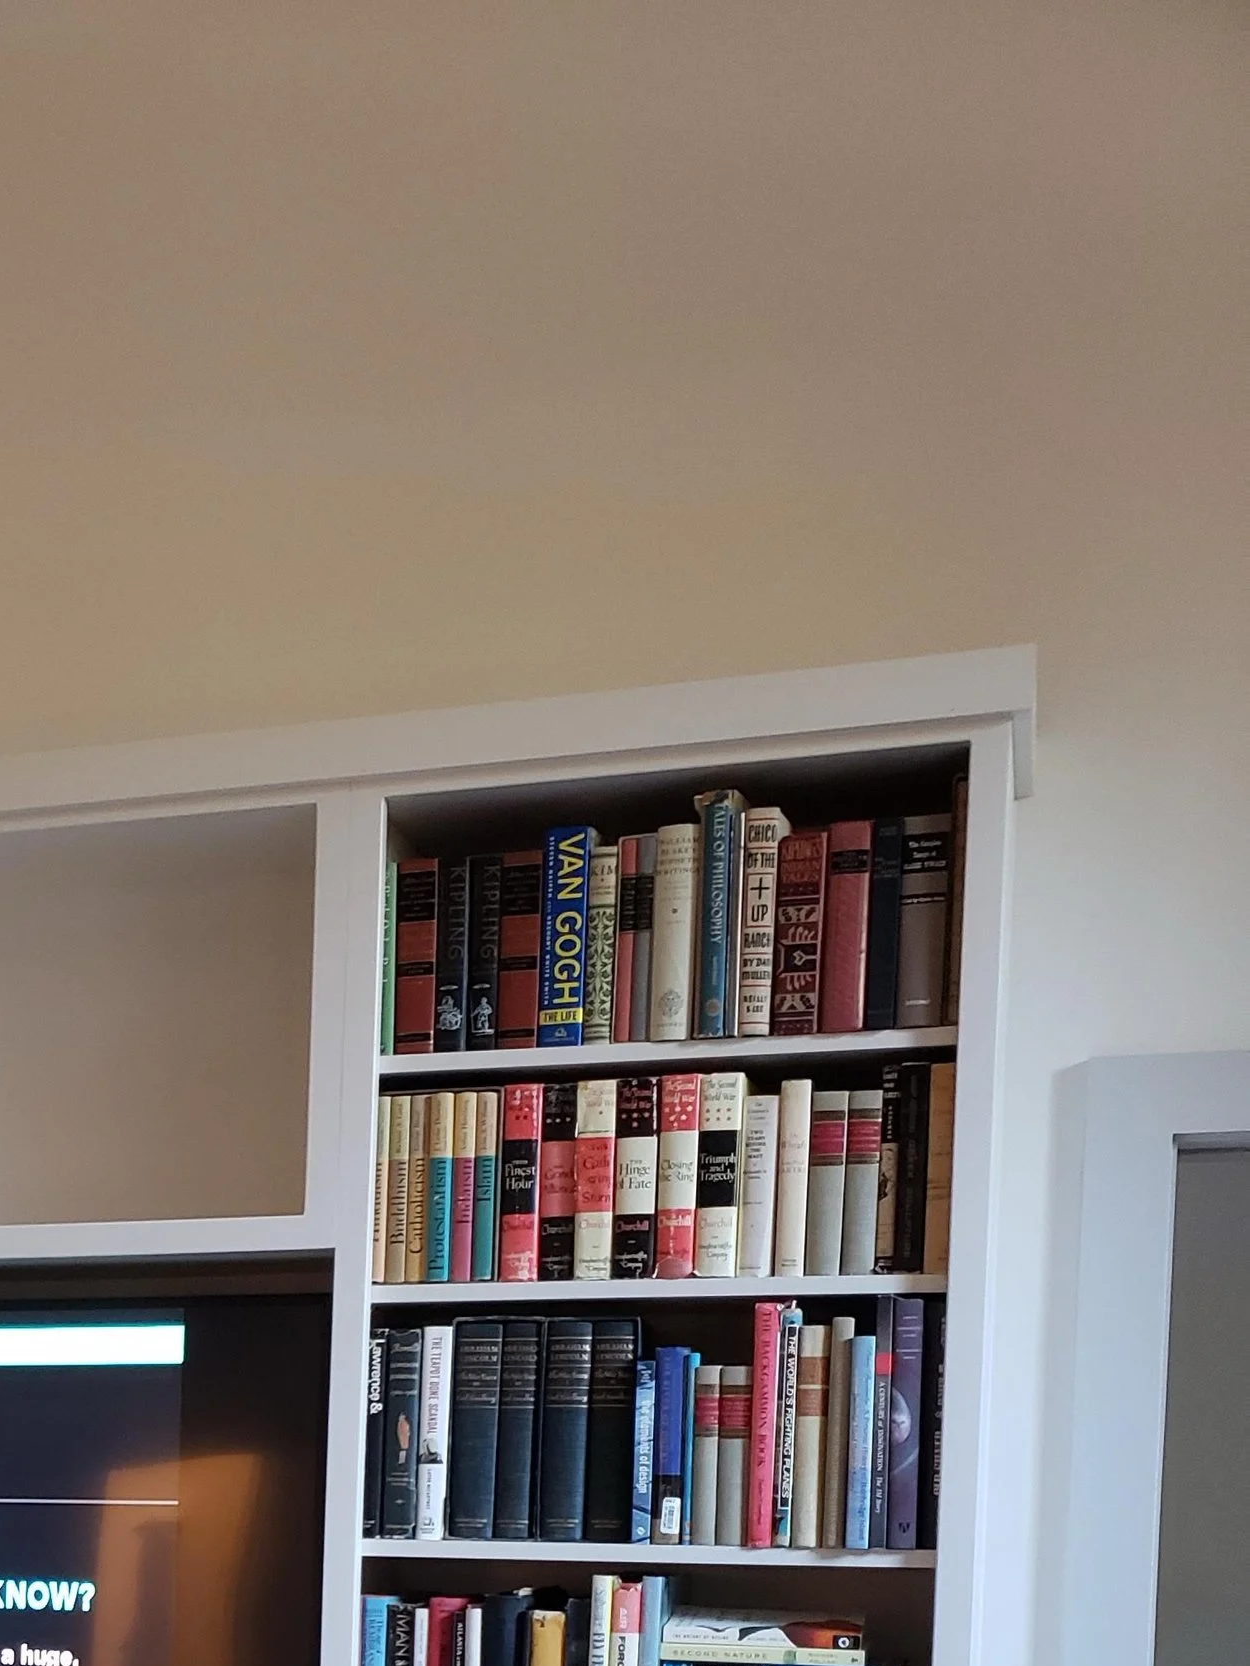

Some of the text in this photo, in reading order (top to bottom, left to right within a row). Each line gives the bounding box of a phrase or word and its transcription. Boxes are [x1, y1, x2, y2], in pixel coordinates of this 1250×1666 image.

[709, 801, 729, 946] TALES OF PHILOSOPHY
[552, 831, 586, 1006] VAN GOGH
[751, 904, 769, 922] UP
[504, 1163, 536, 1177] Finest
[619, 1163, 651, 1177] Hinge
[700, 1153, 737, 1166] Triumph
[709, 1164, 725, 1173] and
[477, 1156, 493, 1203] Islam
[505, 1176, 534, 1190] Hour
[699, 1171, 735, 1184] Tragedy
[389, 1158, 407, 1246] Buddhism
[408, 1157, 426, 1255] Catholicism
[761, 1310, 772, 1333] THE
[757, 1340, 771, 1430] BACKGAMMON
[780, 1336, 798, 1499] THE WORLD'S FIGHTING PLANES
[755, 1433, 767, 1467] BOOK
[619, 1607, 628, 1630] AIR
[0, 1648, 15, 1665] a
